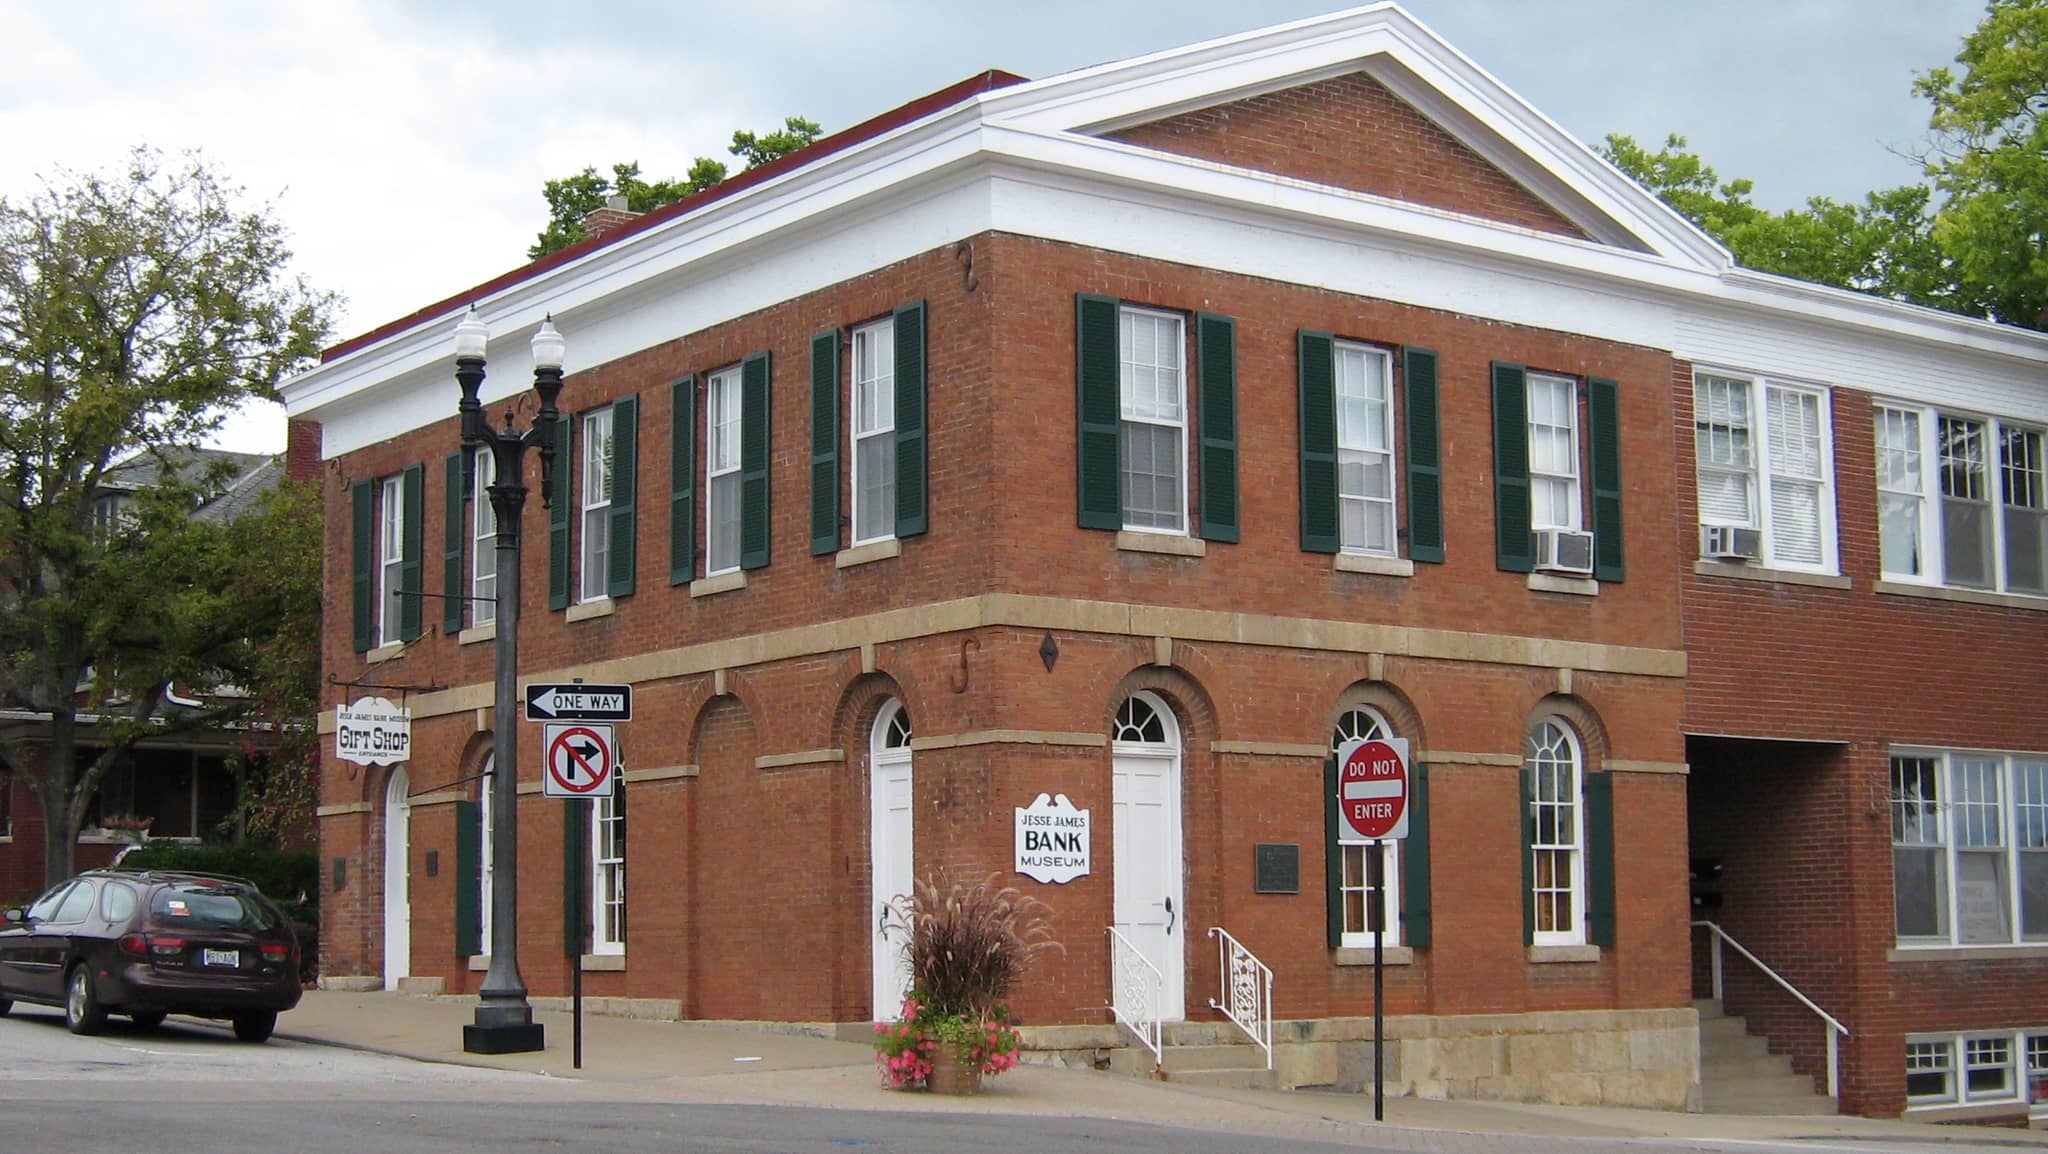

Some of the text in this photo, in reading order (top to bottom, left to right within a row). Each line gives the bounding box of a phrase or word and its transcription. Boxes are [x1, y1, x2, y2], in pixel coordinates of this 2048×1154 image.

[553, 695, 620, 709] ONE WAY
[340, 725, 409, 751] GIFT SHOP
[1349, 759, 1397, 777] DO NOT
[1355, 803, 1393, 819] ENTER
[1021, 815, 1085, 828] JESSE JAMES
[1025, 830, 1082, 853] BANK
[1021, 856, 1085, 867] MUSEUM
